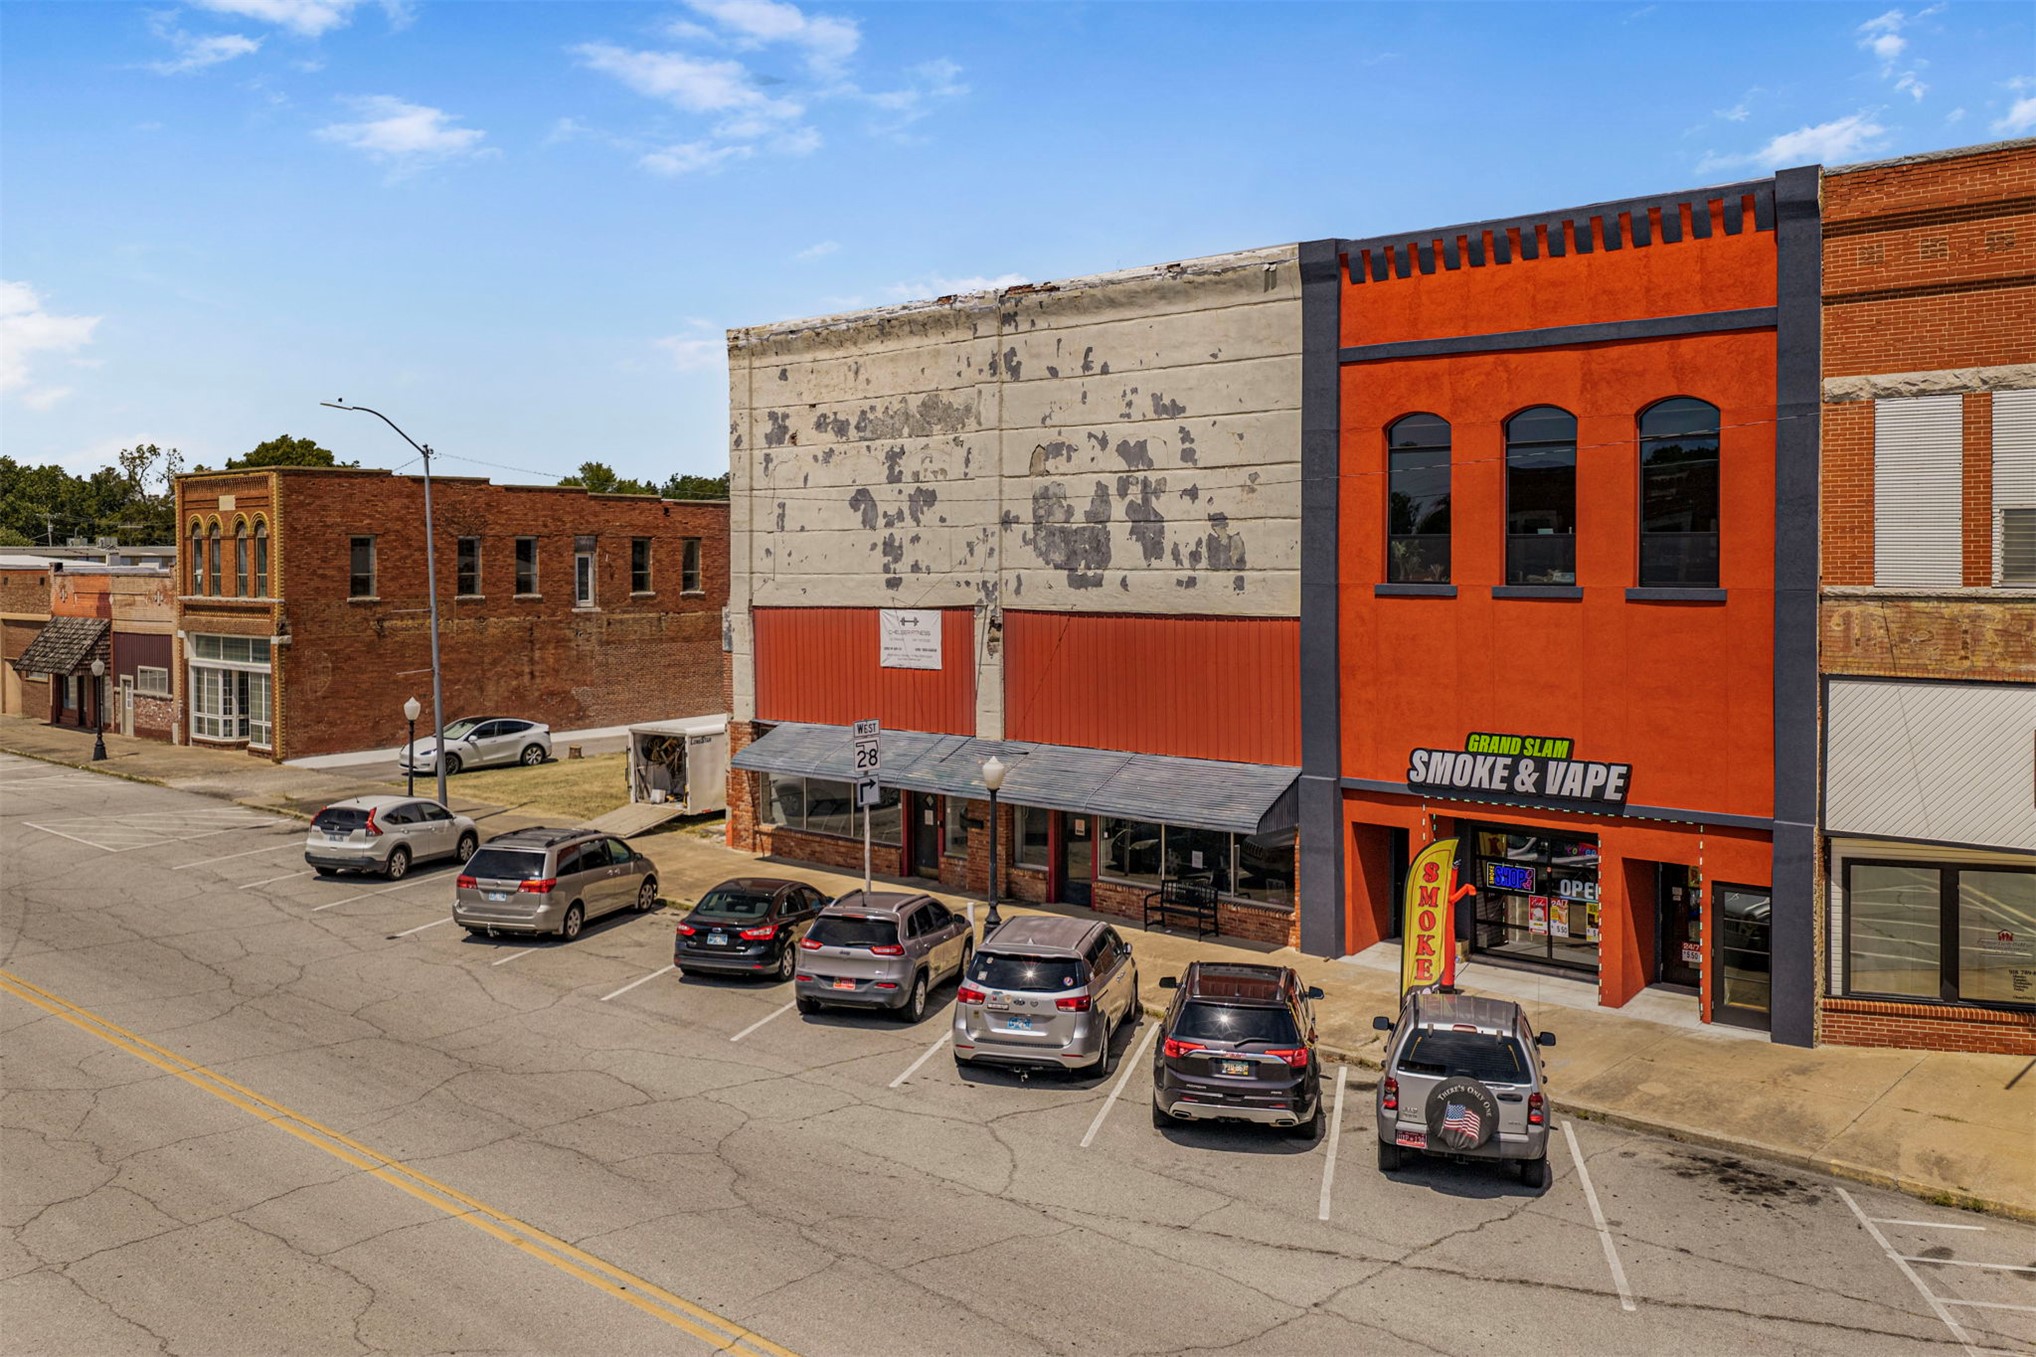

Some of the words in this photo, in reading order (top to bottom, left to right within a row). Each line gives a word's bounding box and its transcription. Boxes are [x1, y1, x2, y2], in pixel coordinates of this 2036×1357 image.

[857, 723, 877, 734] WEST
[1467, 734, 1521, 756] GRAND
[1523, 737, 1570, 758] SLAM
[857, 748, 878, 769] 28
[1409, 749, 1512, 791] SMOKE
[1513, 758, 1540, 794] &
[1545, 760, 1628, 801] VAPE
[1495, 866, 1526, 889] SHOP
[1414, 861, 1440, 981] SMOKE
